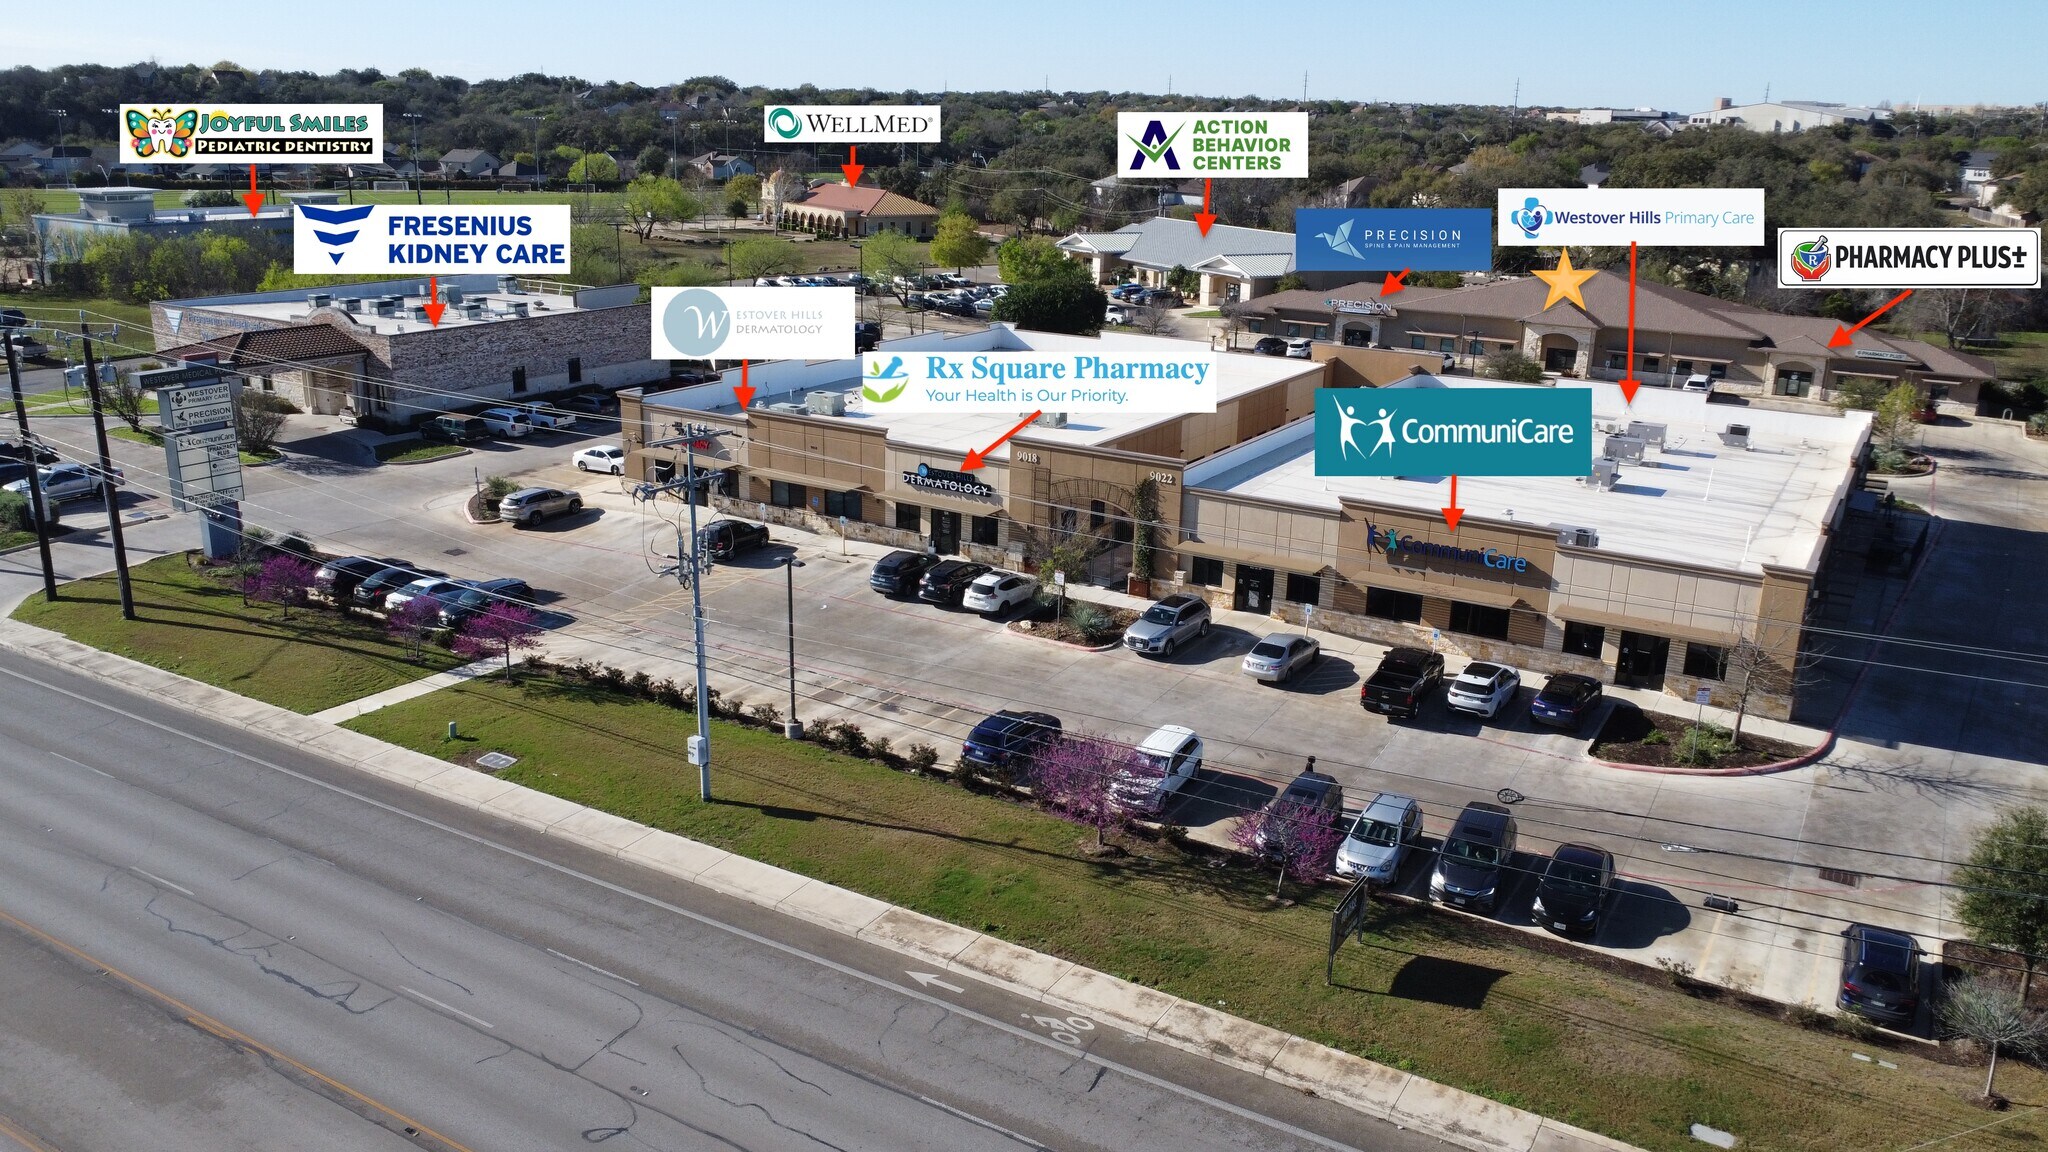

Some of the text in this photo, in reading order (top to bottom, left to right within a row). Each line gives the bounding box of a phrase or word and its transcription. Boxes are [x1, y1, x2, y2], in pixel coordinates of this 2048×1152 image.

[1331, 299, 1392, 311] PRECISION
[143, 373, 180, 385] WESTOVER
[182, 369, 213, 380] MEDICAL
[187, 386, 229, 398] WESTOVER
[187, 395, 213, 404] PRIMARY
[188, 407, 231, 420] PRECISION
[1017, 451, 1037, 463] 9018
[1150, 471, 1173, 484] 9022
[903, 474, 988, 495] DERMATOLOGY
[1401, 535, 1527, 573] CommuniCare
